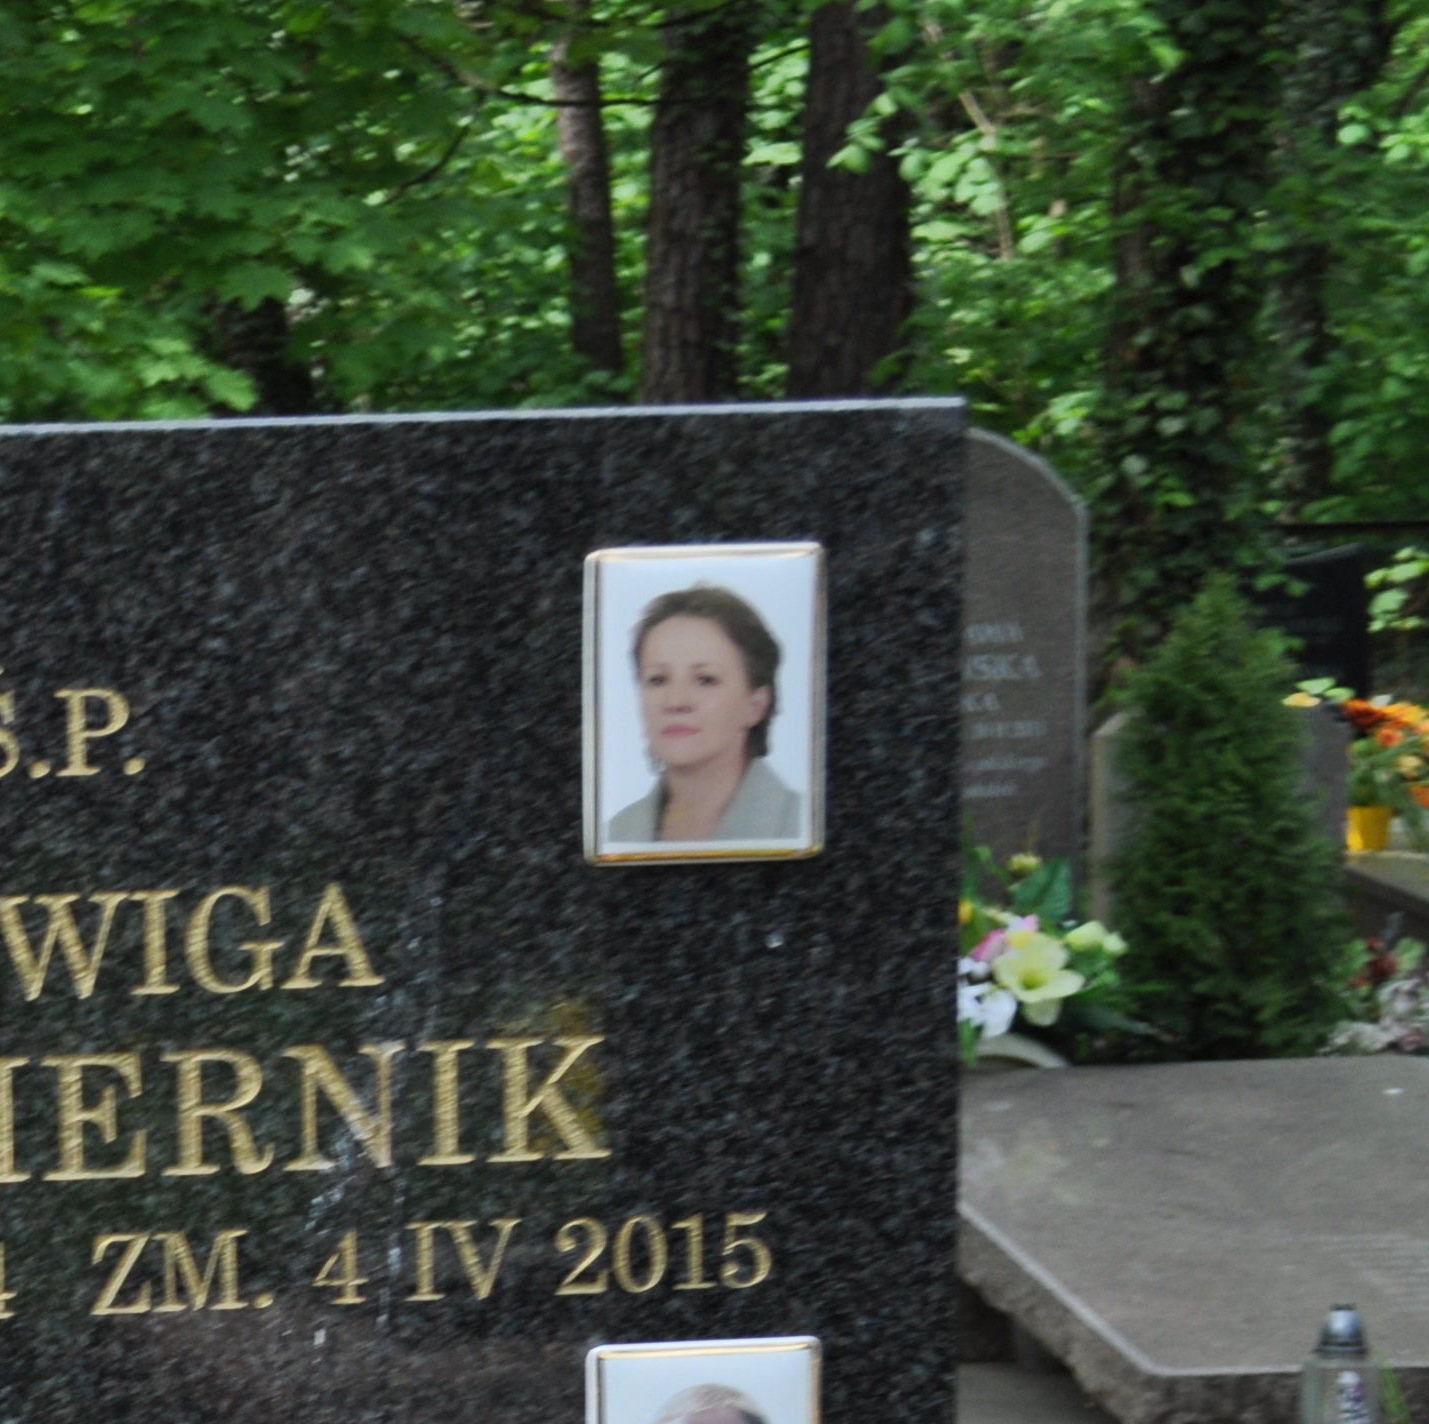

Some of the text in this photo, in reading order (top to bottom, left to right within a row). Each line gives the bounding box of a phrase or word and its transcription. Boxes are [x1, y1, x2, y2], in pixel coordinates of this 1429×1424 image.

[89, 1228, 276, 1318] ZM.
[312, 1230, 368, 1307] 4
[407, 1219, 521, 1303] IV
[554, 1210, 775, 1298] 2015
